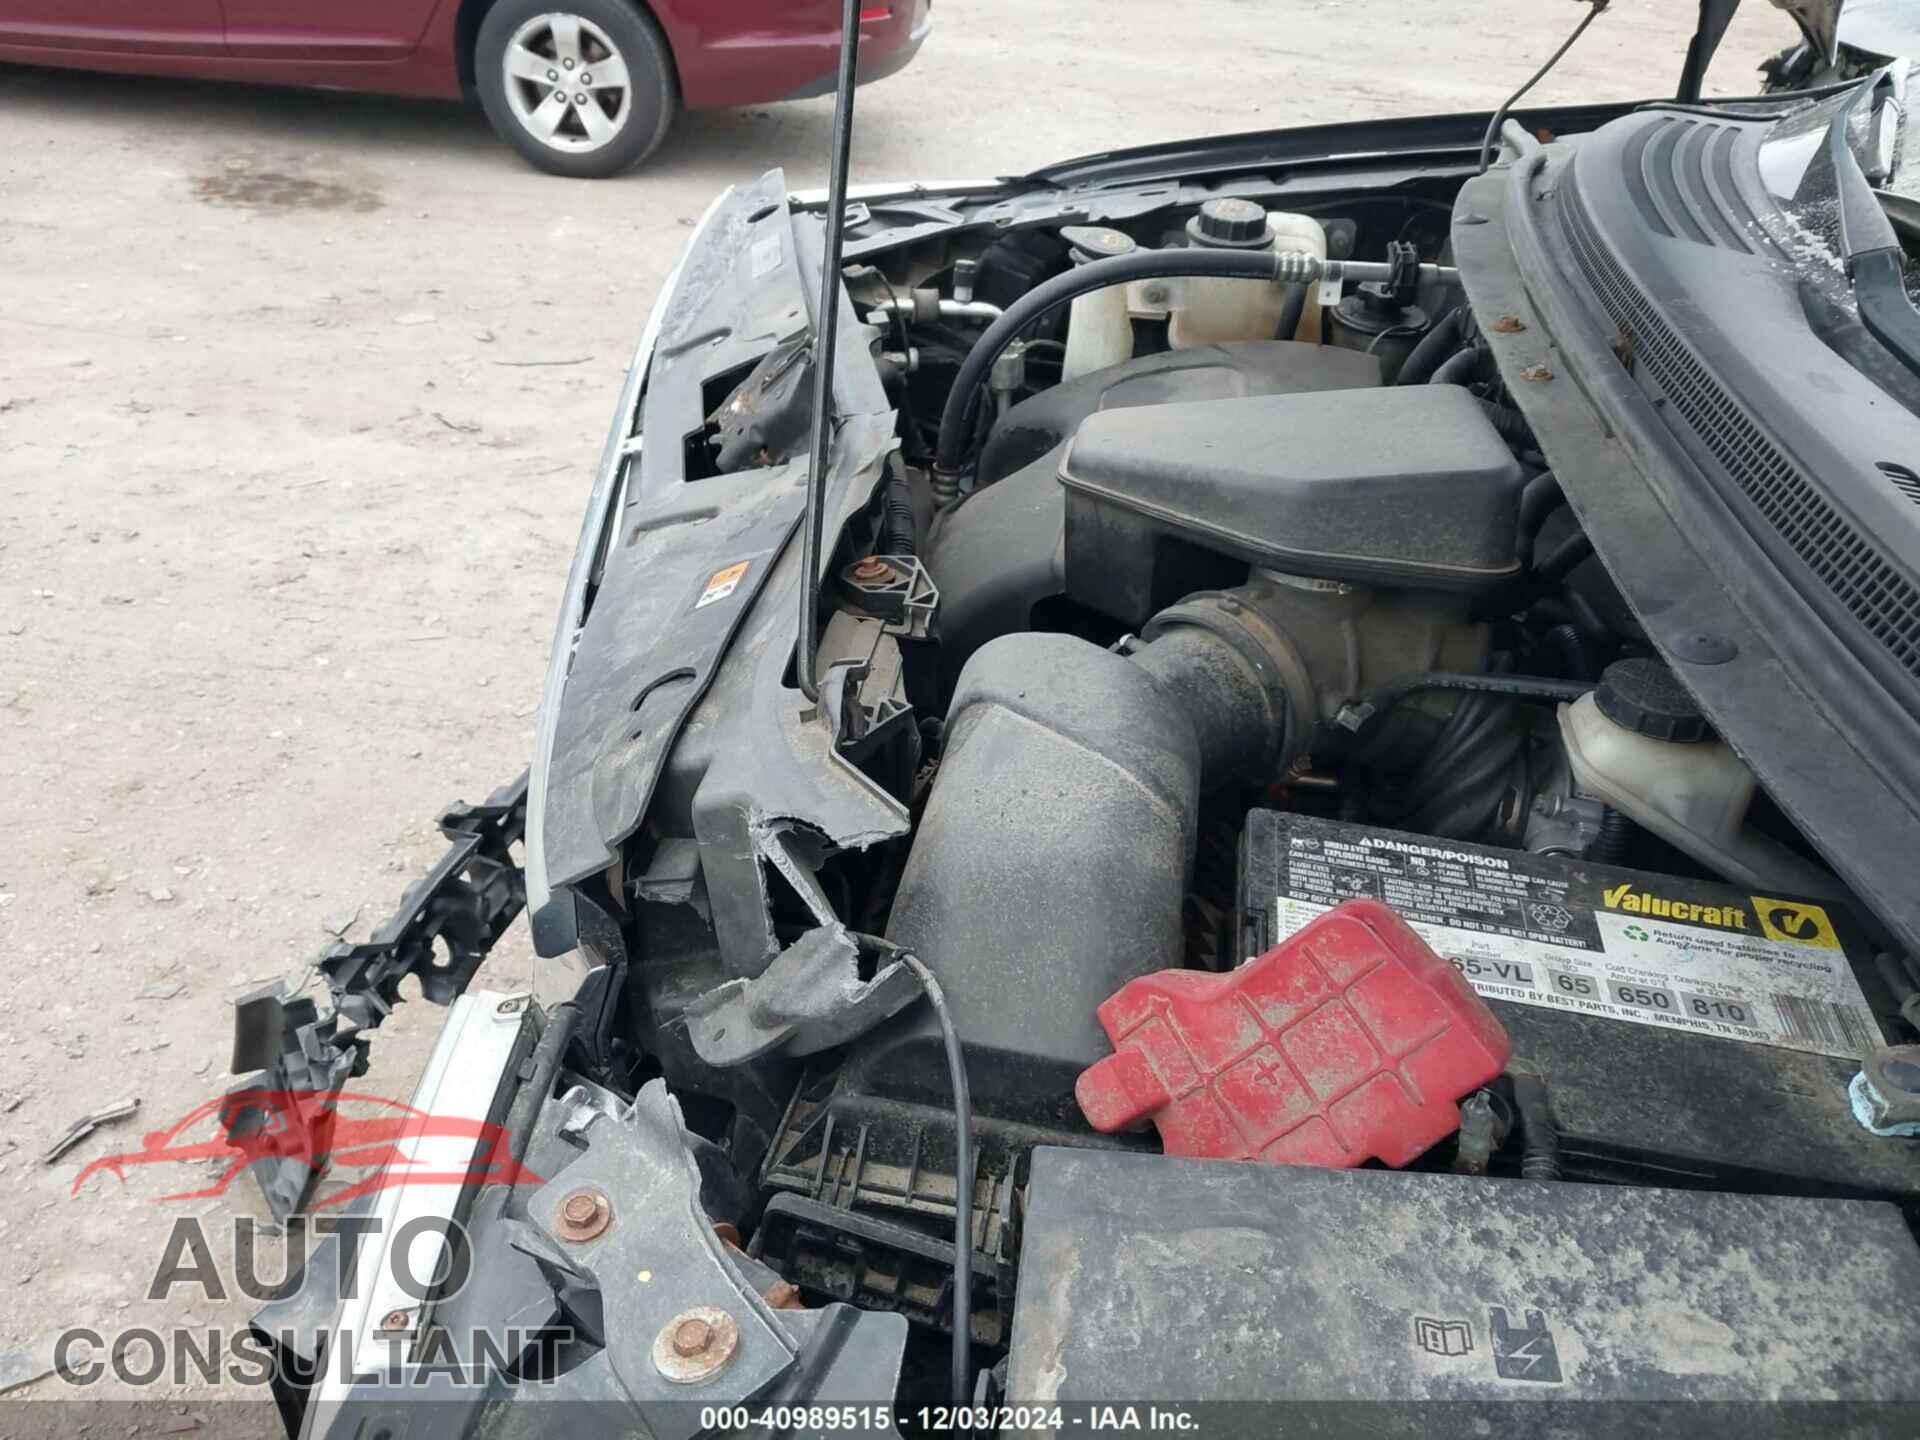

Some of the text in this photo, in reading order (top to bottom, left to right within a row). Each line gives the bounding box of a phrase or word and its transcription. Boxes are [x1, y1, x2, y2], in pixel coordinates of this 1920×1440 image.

[1350, 844, 1371, 855] EYES
[1373, 838, 1510, 870] DANGER/POISON
[1603, 883, 1747, 929] Valucraft
[1653, 928, 1692, 942] Return
[1696, 938, 1725, 949] used
[1557, 974, 1593, 995] 65
[1528, 991, 1544, 1001] BY
[1546, 994, 1575, 1006] BEST
[1617, 986, 1670, 1010] 650
[1692, 997, 1746, 1022] 810
